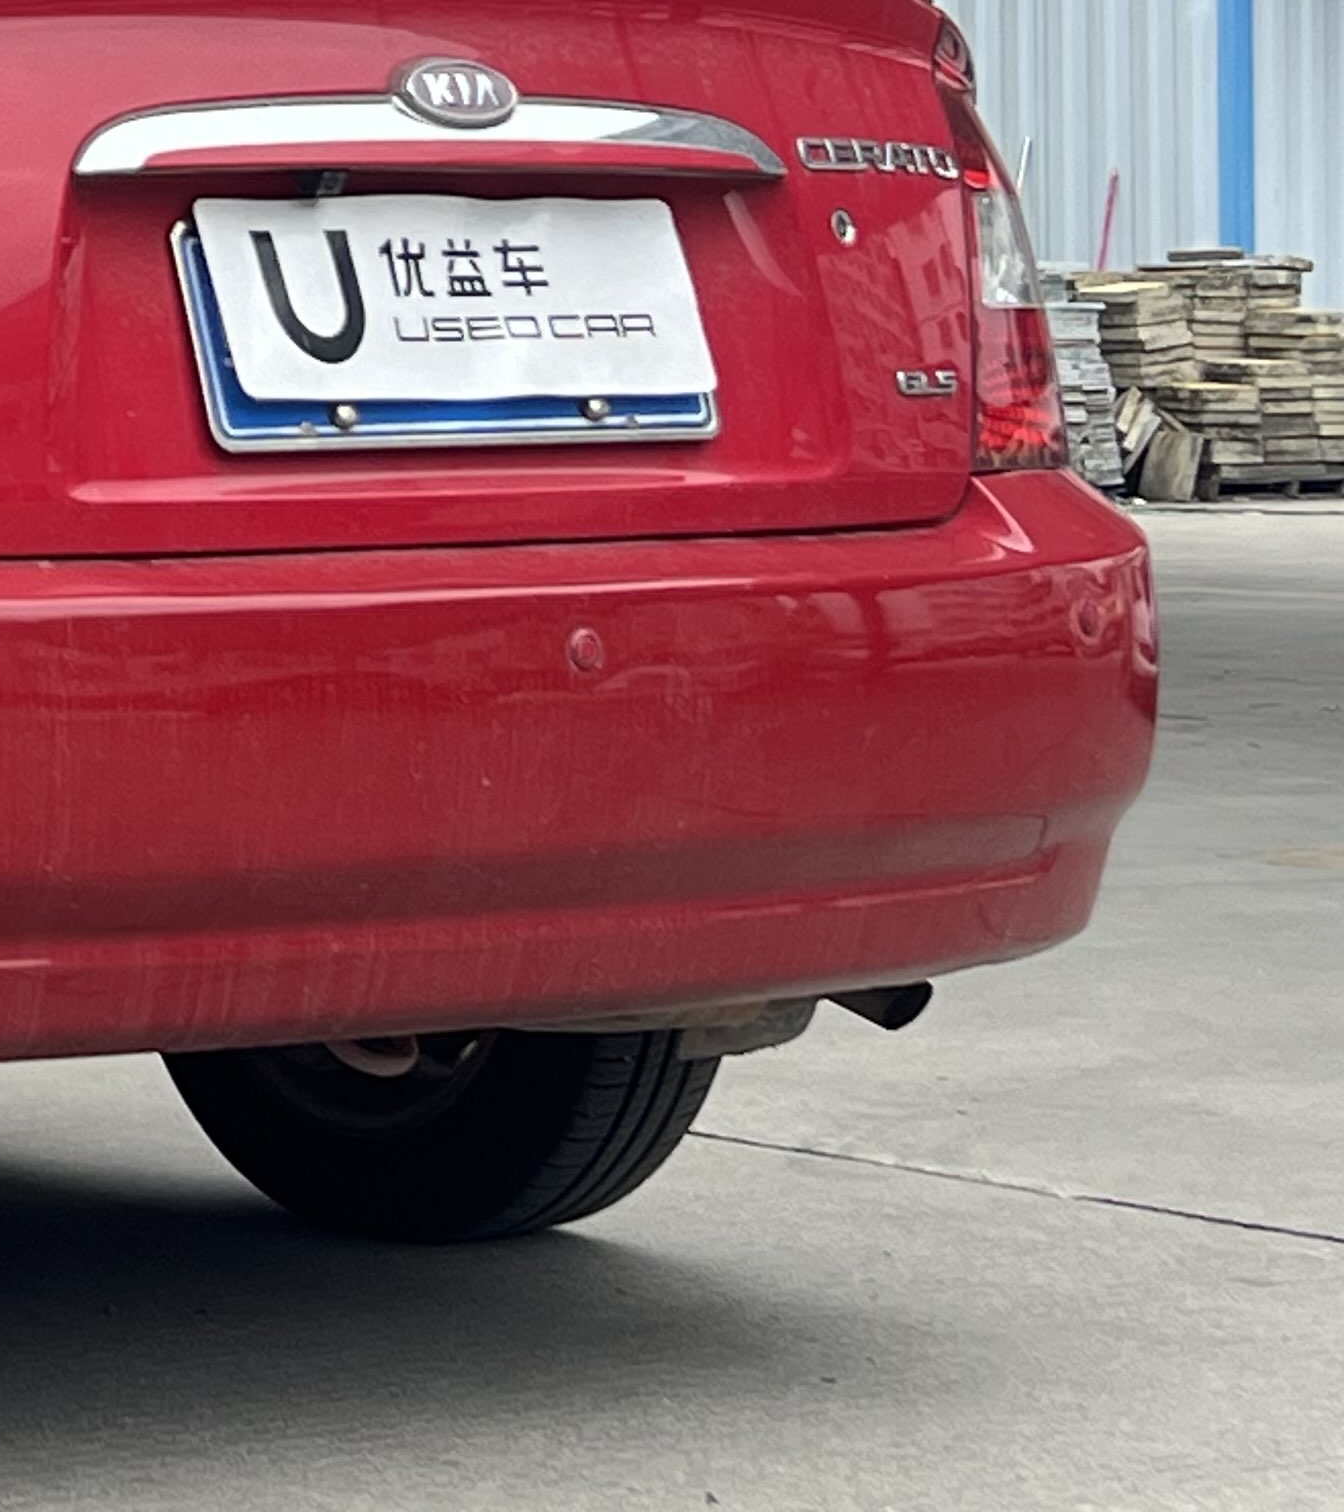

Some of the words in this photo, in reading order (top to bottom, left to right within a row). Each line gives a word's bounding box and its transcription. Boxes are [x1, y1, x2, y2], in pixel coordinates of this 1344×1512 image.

[420, 72, 500, 105] KIA
[797, 137, 960, 179] CERATO
[378, 237, 550, 299] 优益车
[248, 229, 366, 365] U
[393, 314, 542, 344] USED
[548, 313, 656, 342] CAR
